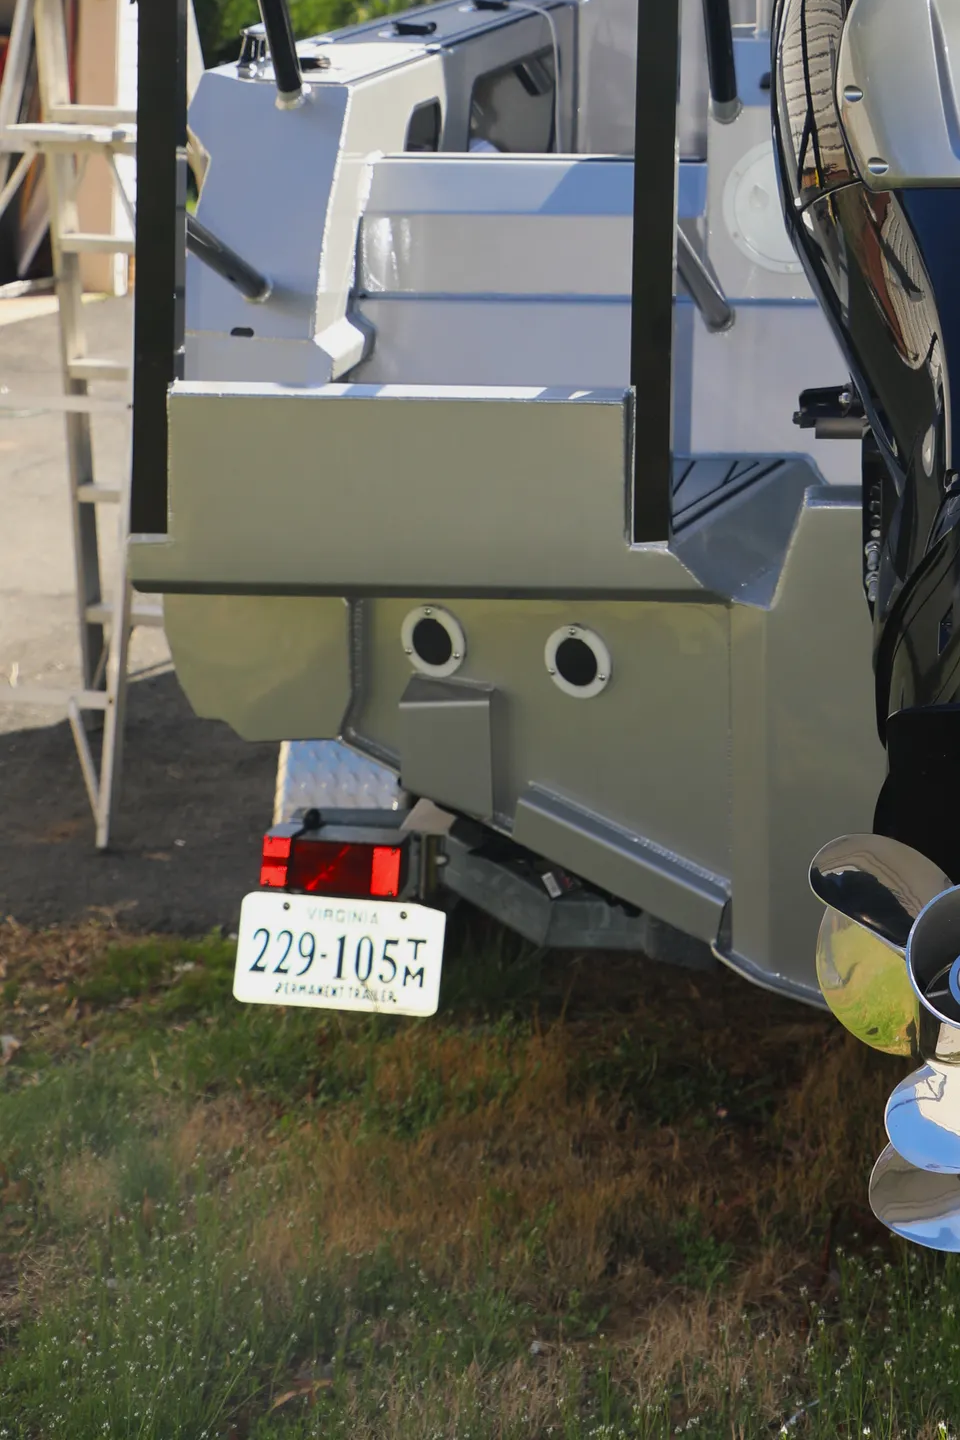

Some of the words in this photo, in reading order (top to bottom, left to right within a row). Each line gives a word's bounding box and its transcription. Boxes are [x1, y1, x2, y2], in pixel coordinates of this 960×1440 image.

[307, 907, 379, 925] VIRGINIA
[249, 928, 399, 983] 229-105
[275, 982, 344, 999] PERMANENT
[348, 986, 397, 1002] TRAILER
